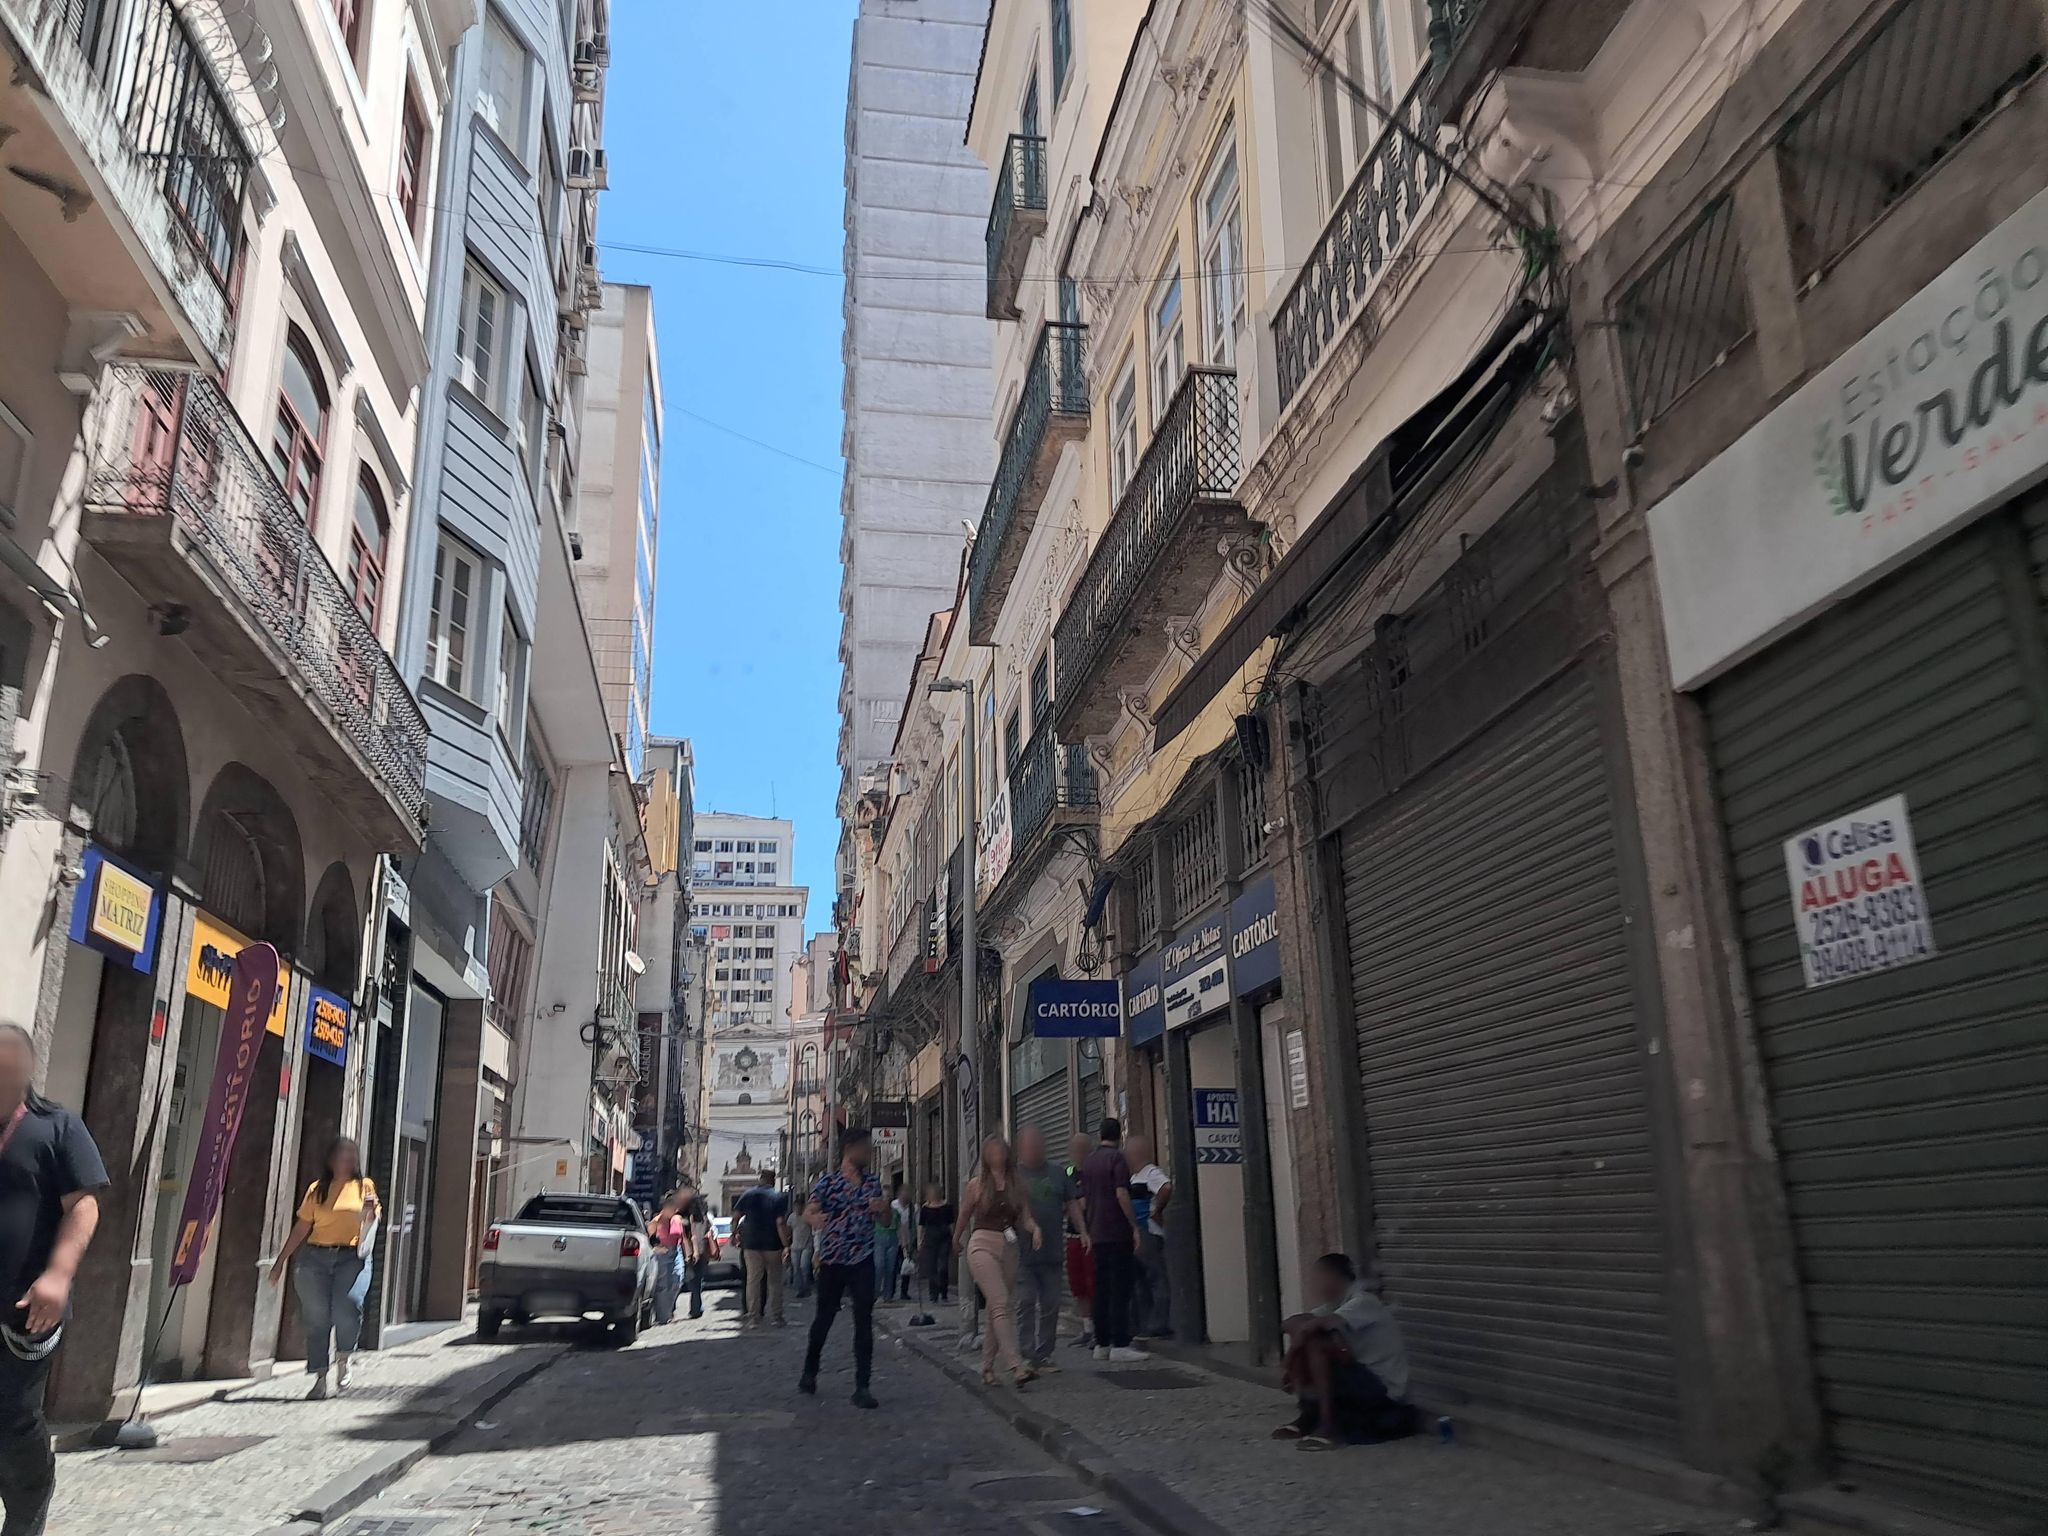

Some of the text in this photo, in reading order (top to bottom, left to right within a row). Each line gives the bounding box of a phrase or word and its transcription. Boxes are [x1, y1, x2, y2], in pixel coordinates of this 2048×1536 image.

[1840, 312, 2048, 512] Verde
[1801, 852, 1910, 912] ALUGA
[100, 894, 144, 937] MATRIZ
[1191, 934, 1200, 955] de
[1200, 926, 1221, 949] Notas
[1038, 999, 1119, 1018] CARTÓRIO
[1128, 984, 1159, 1018] CARTÓRIO
